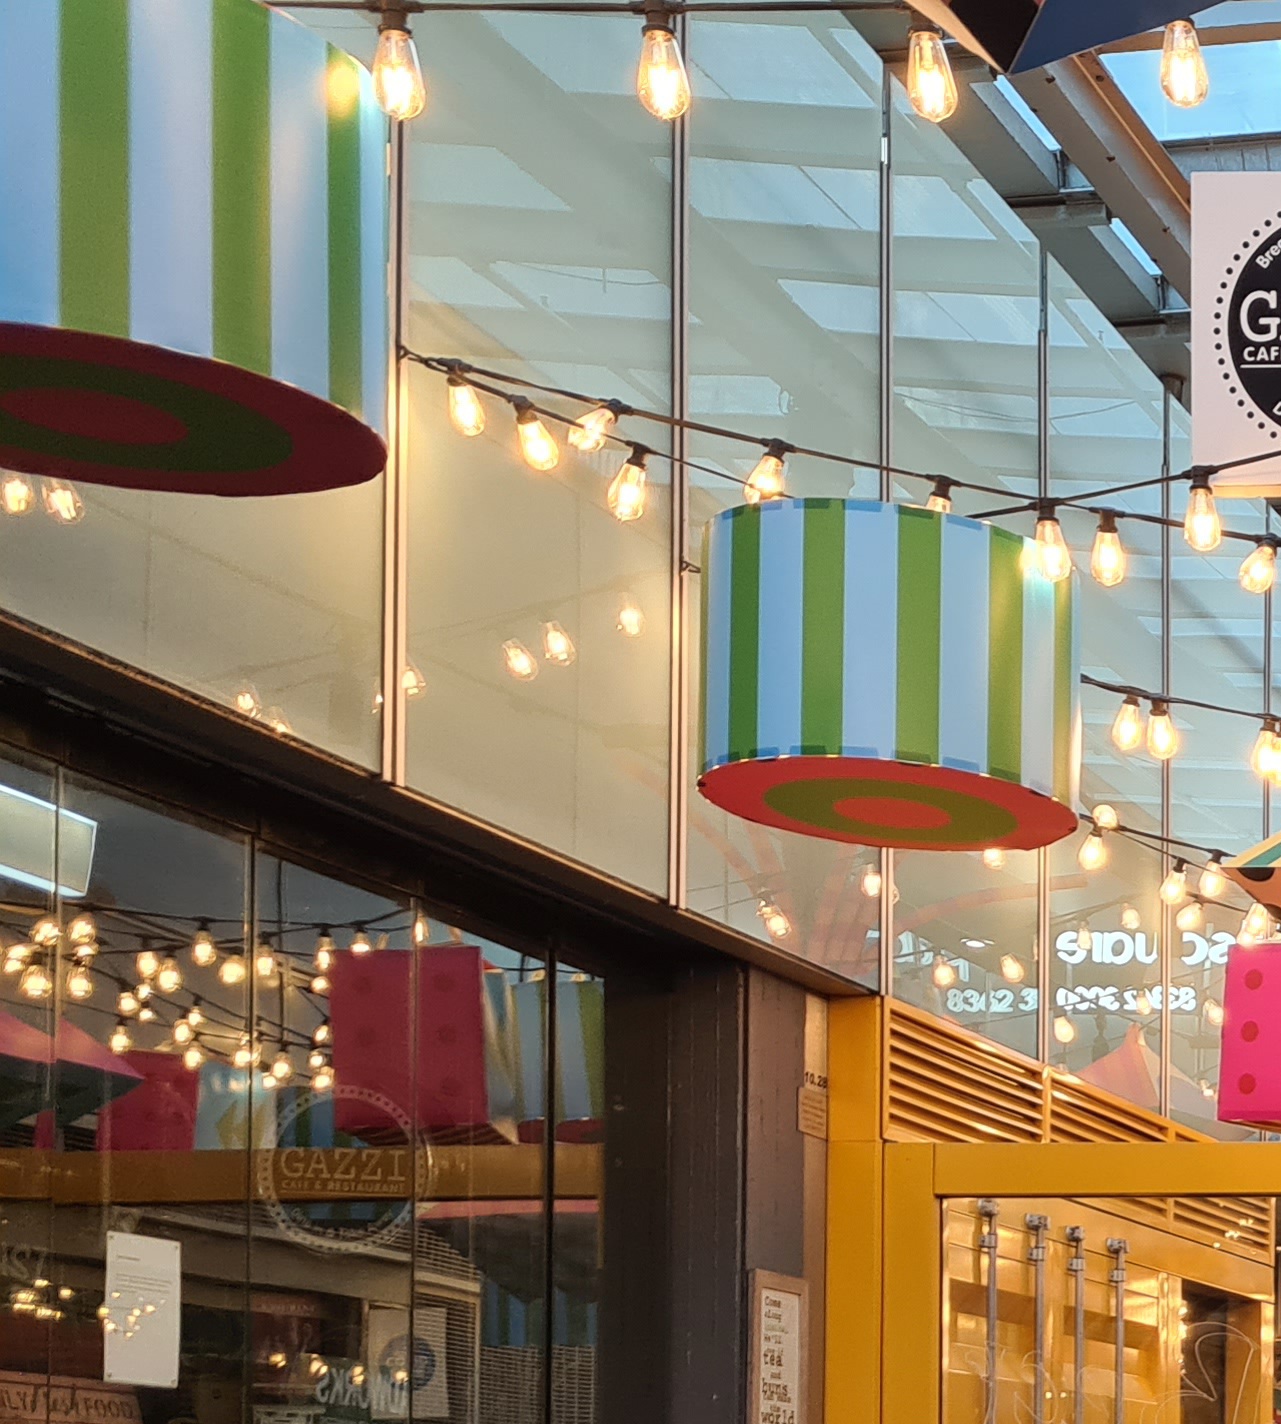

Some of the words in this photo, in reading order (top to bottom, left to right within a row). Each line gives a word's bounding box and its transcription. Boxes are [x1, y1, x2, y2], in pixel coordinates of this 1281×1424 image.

[281, 1150, 406, 1182] GAZZI
[327, 1181, 405, 1194] RESTAURANT
[763, 1352, 784, 1368] tea
[761, 1377, 788, 1397] buns
